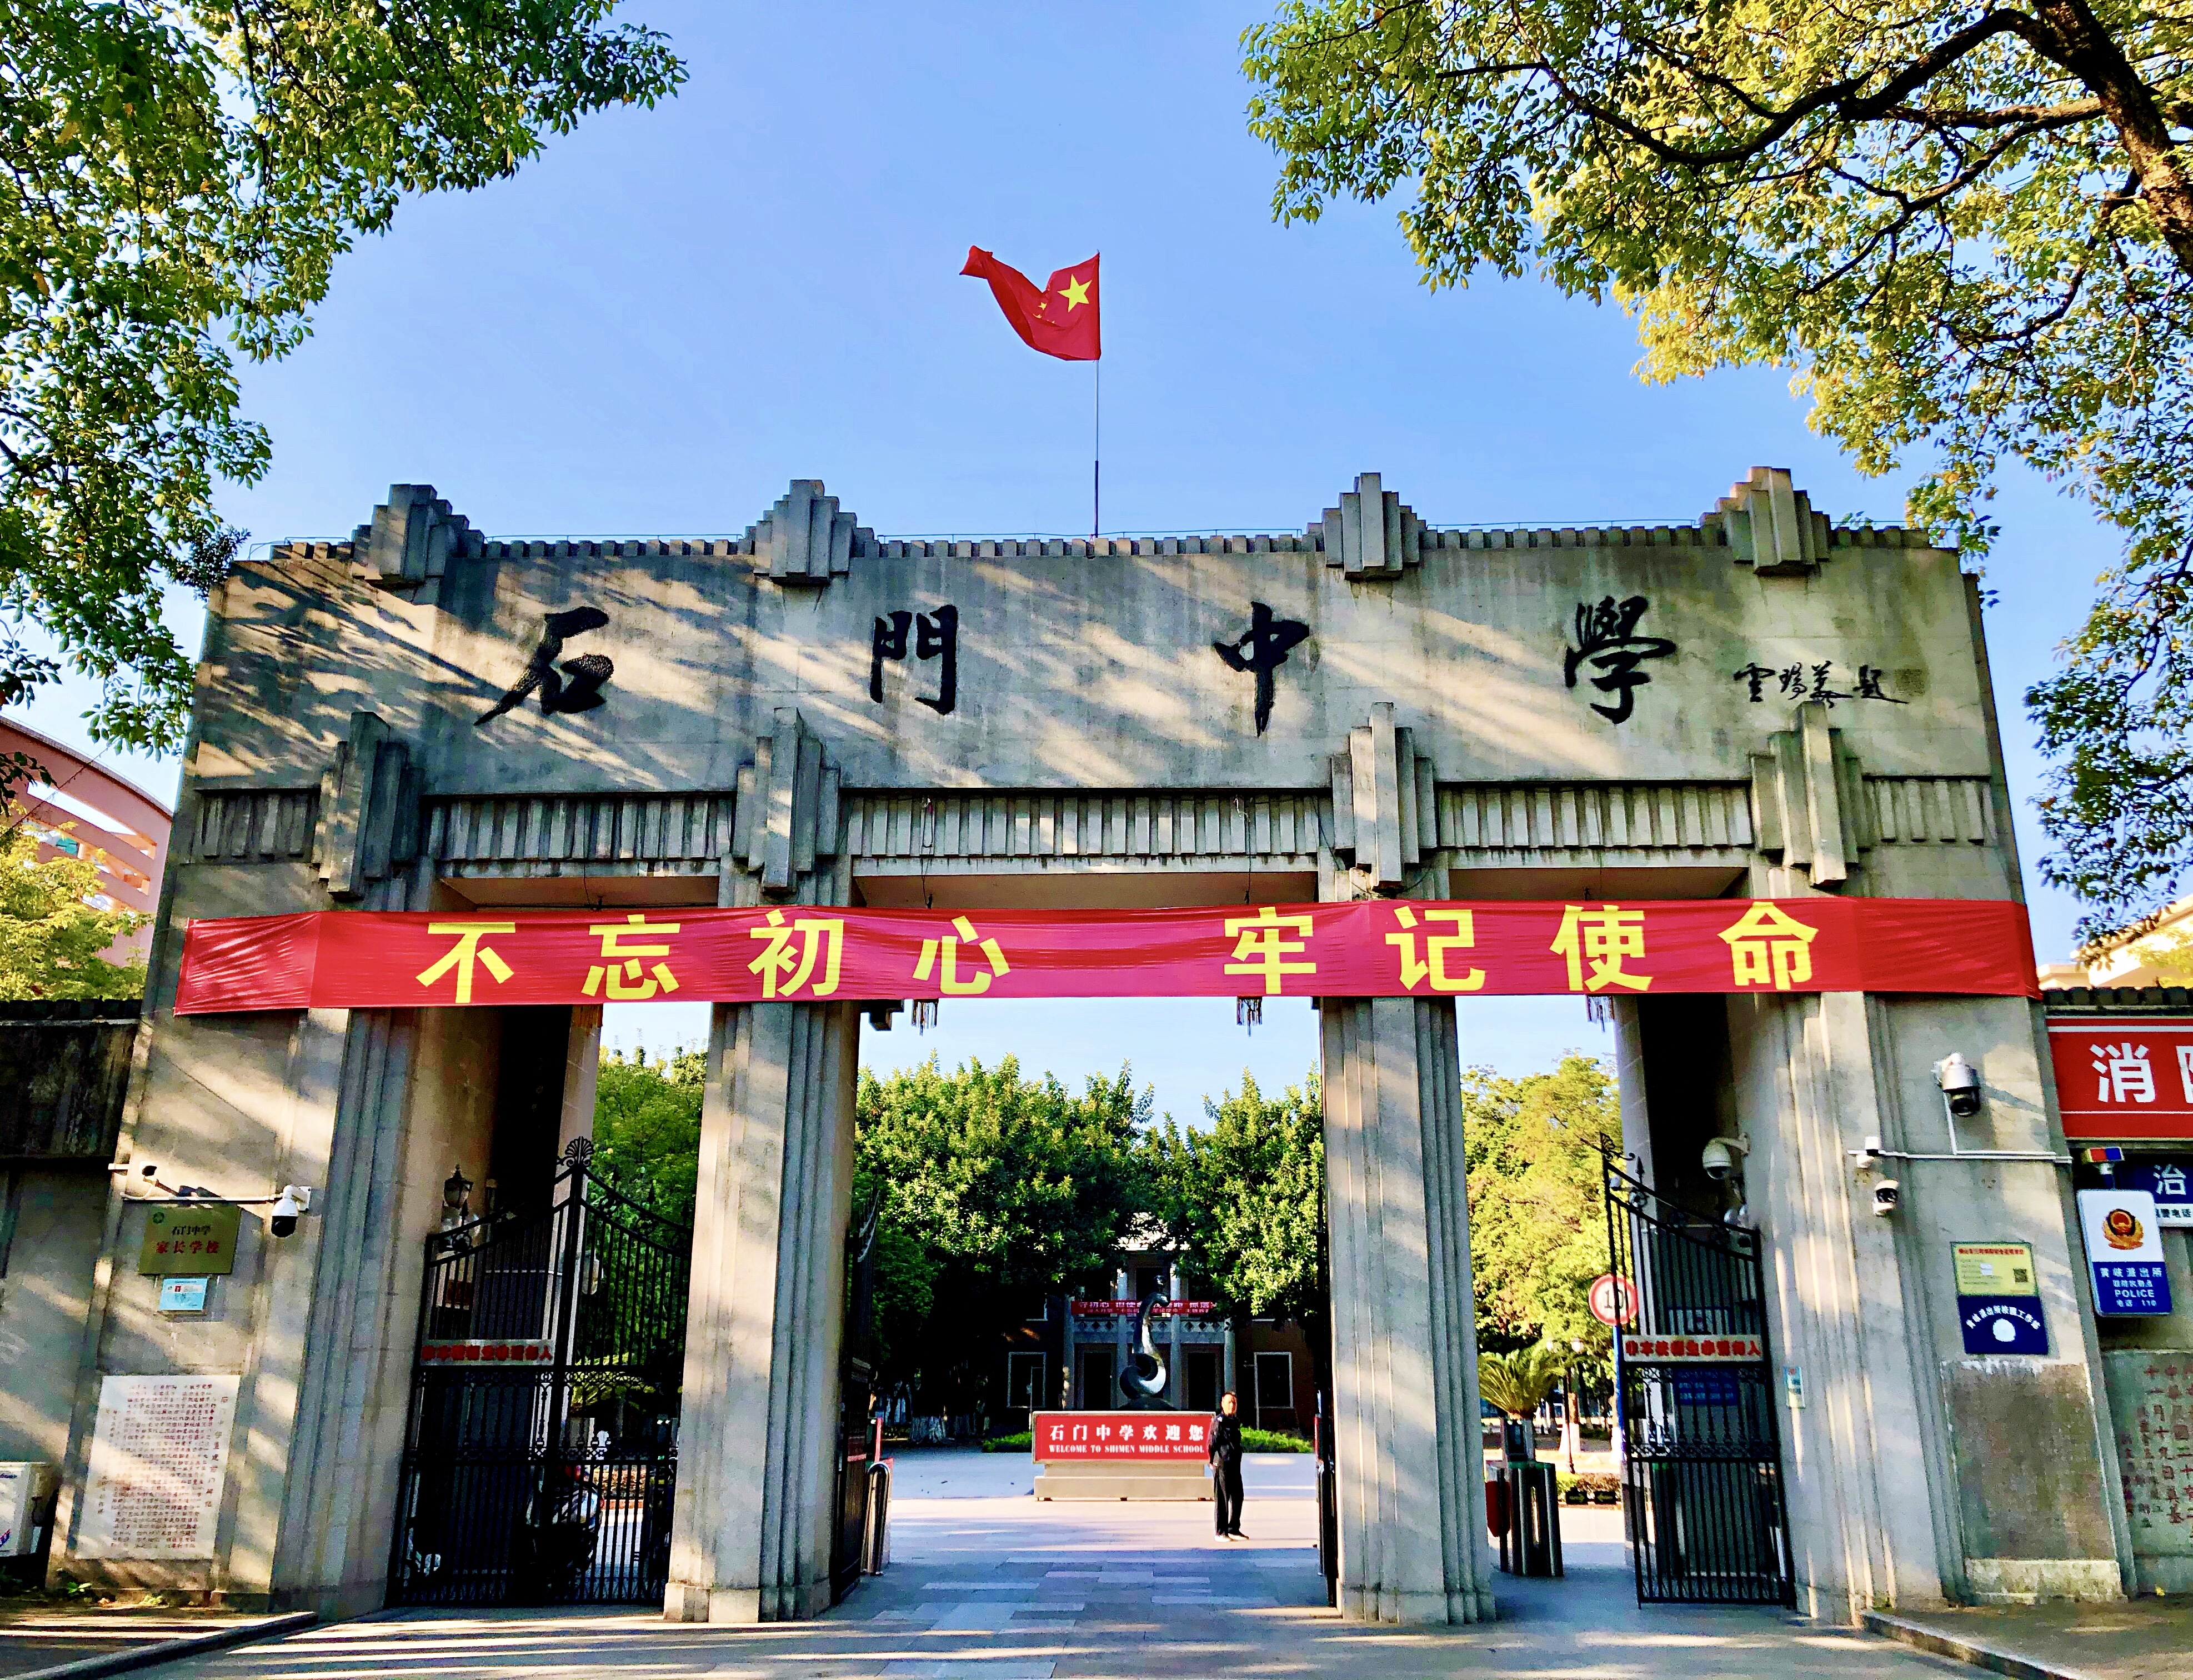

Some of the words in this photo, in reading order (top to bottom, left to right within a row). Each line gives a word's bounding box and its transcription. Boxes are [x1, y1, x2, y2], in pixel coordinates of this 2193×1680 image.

[473, 596, 1678, 737] 石門中學
[415, 909, 1011, 1004] 不忘初心
[1223, 901, 1820, 995] 牢记使命
[156, 1239, 219, 1254] 家长学校
[2114, 1289, 2155, 1298] POLICE
[1050, 1424, 1204, 1441] 石门中学欢迎您
[1049, 1444, 1087, 1453] WELCOME
[1090, 1444, 1101, 1453] TO
[1104, 1444, 1135, 1453] SHIMEN
[1139, 1444, 1169, 1453] MIDDLE
[1173, 1444, 1204, 1453] SCHOOL
